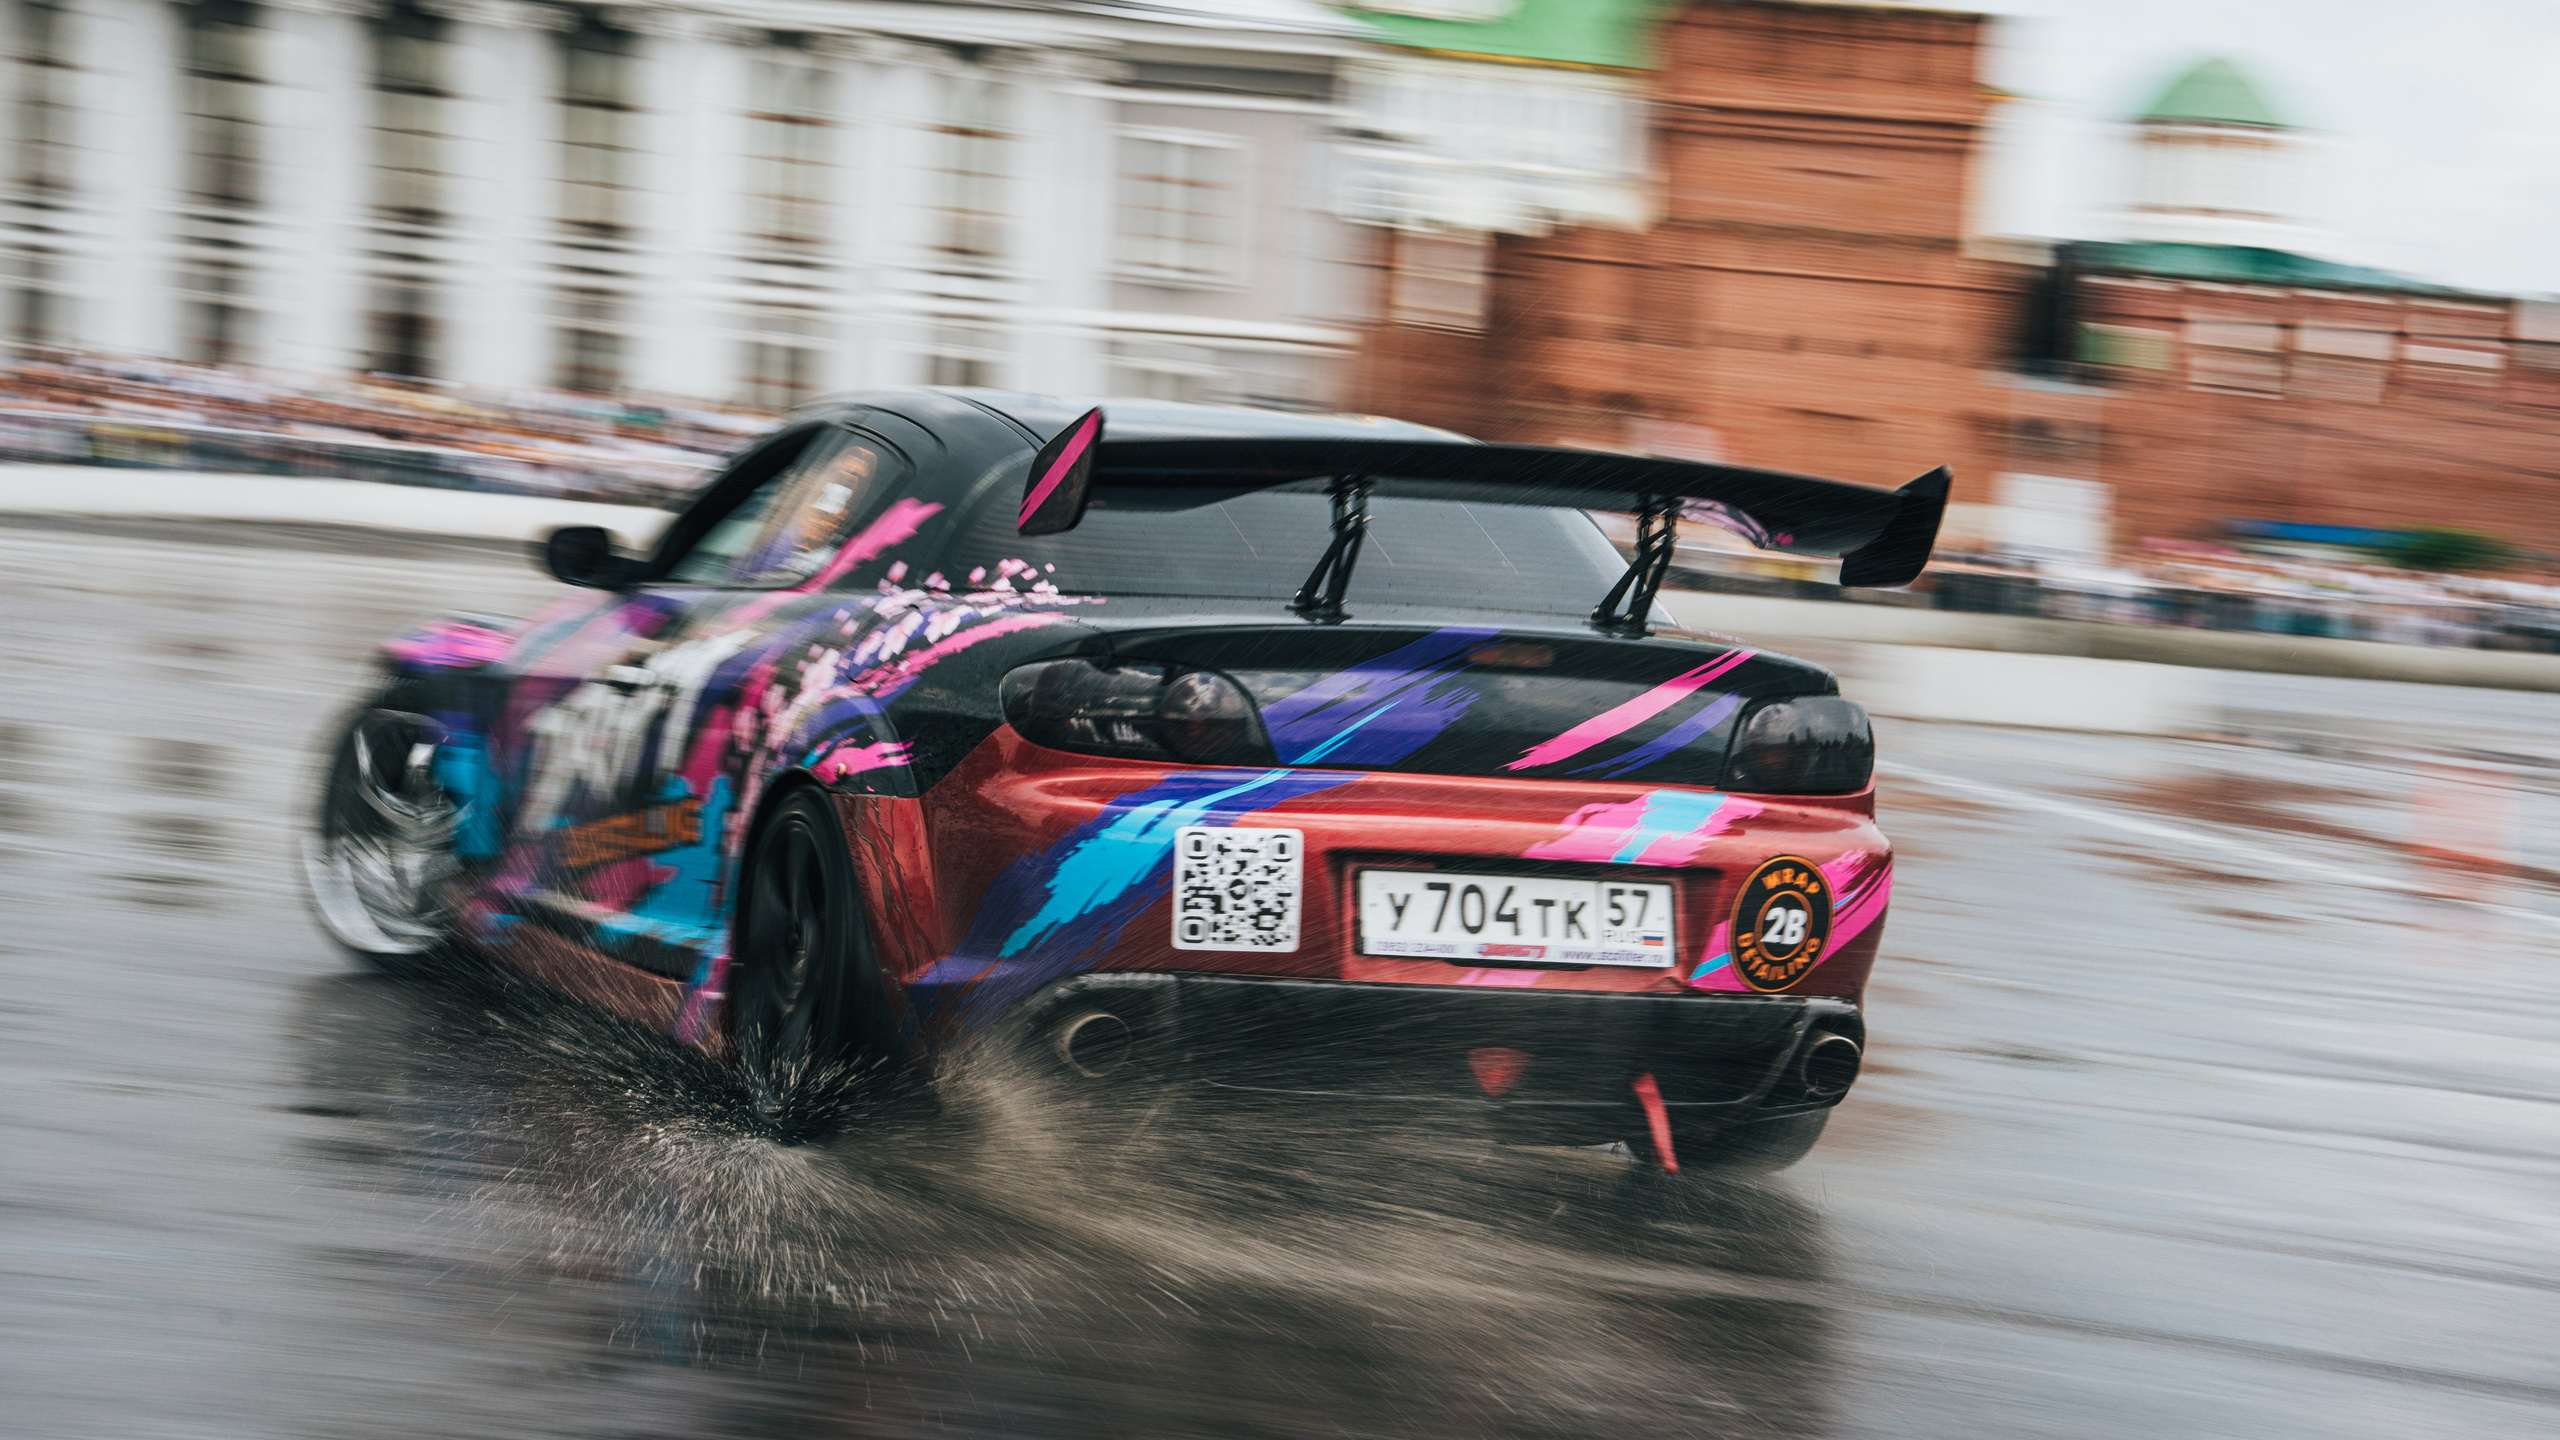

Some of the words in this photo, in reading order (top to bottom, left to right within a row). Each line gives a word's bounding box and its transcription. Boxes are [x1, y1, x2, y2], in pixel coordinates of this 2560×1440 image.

[1762, 868, 1820, 894] WRAP
[1608, 888, 1650, 927] 57
[1760, 907, 1808, 945] 2B
[1738, 933, 1821, 980] DETAILING
